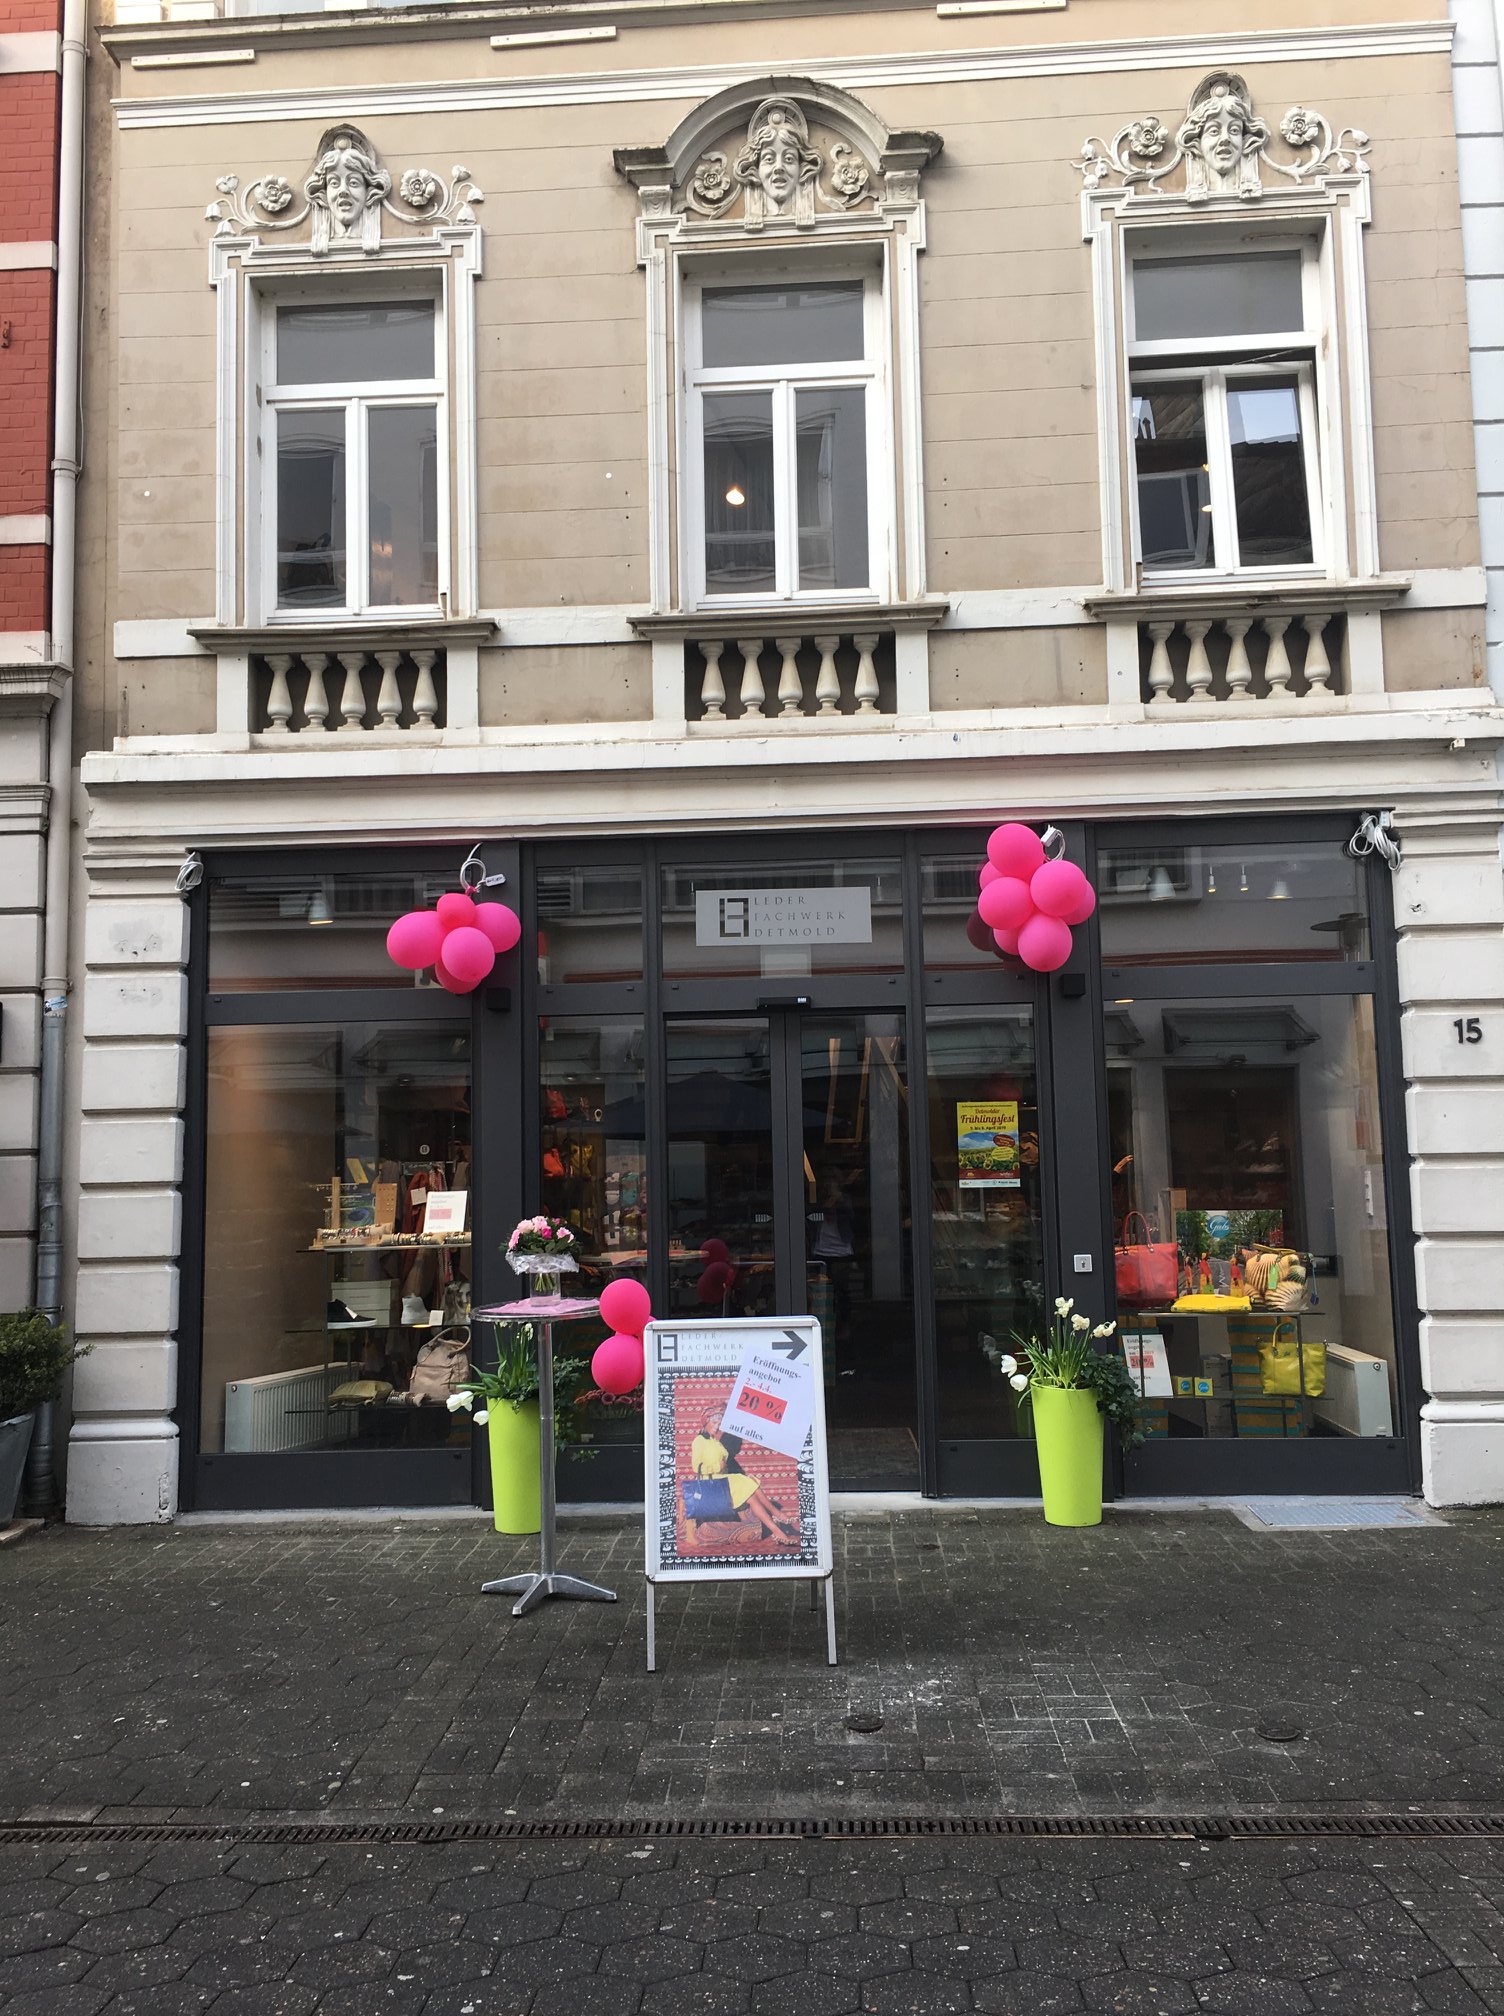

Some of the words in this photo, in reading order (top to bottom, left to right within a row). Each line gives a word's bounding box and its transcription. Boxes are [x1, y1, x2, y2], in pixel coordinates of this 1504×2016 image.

[754, 896, 805, 905] LEDER
[754, 911, 846, 921] FACHWERK
[754, 927, 835, 937] DETMOLD
[1453, 1018, 1482, 1043] 15
[960, 1114, 1015, 1125] Frühlingsfest
[682, 1343, 744, 1351] FACHWERK
[682, 1354, 737, 1362] DETMOLD
[753, 1356, 802, 1379] Eröffnungs-
[748, 1368, 782, 1384] angebot
[739, 1392, 760, 1410] 20
[766, 1401, 782, 1419] %
[729, 1424, 744, 1433] auf
[745, 1429, 763, 1441] alles
